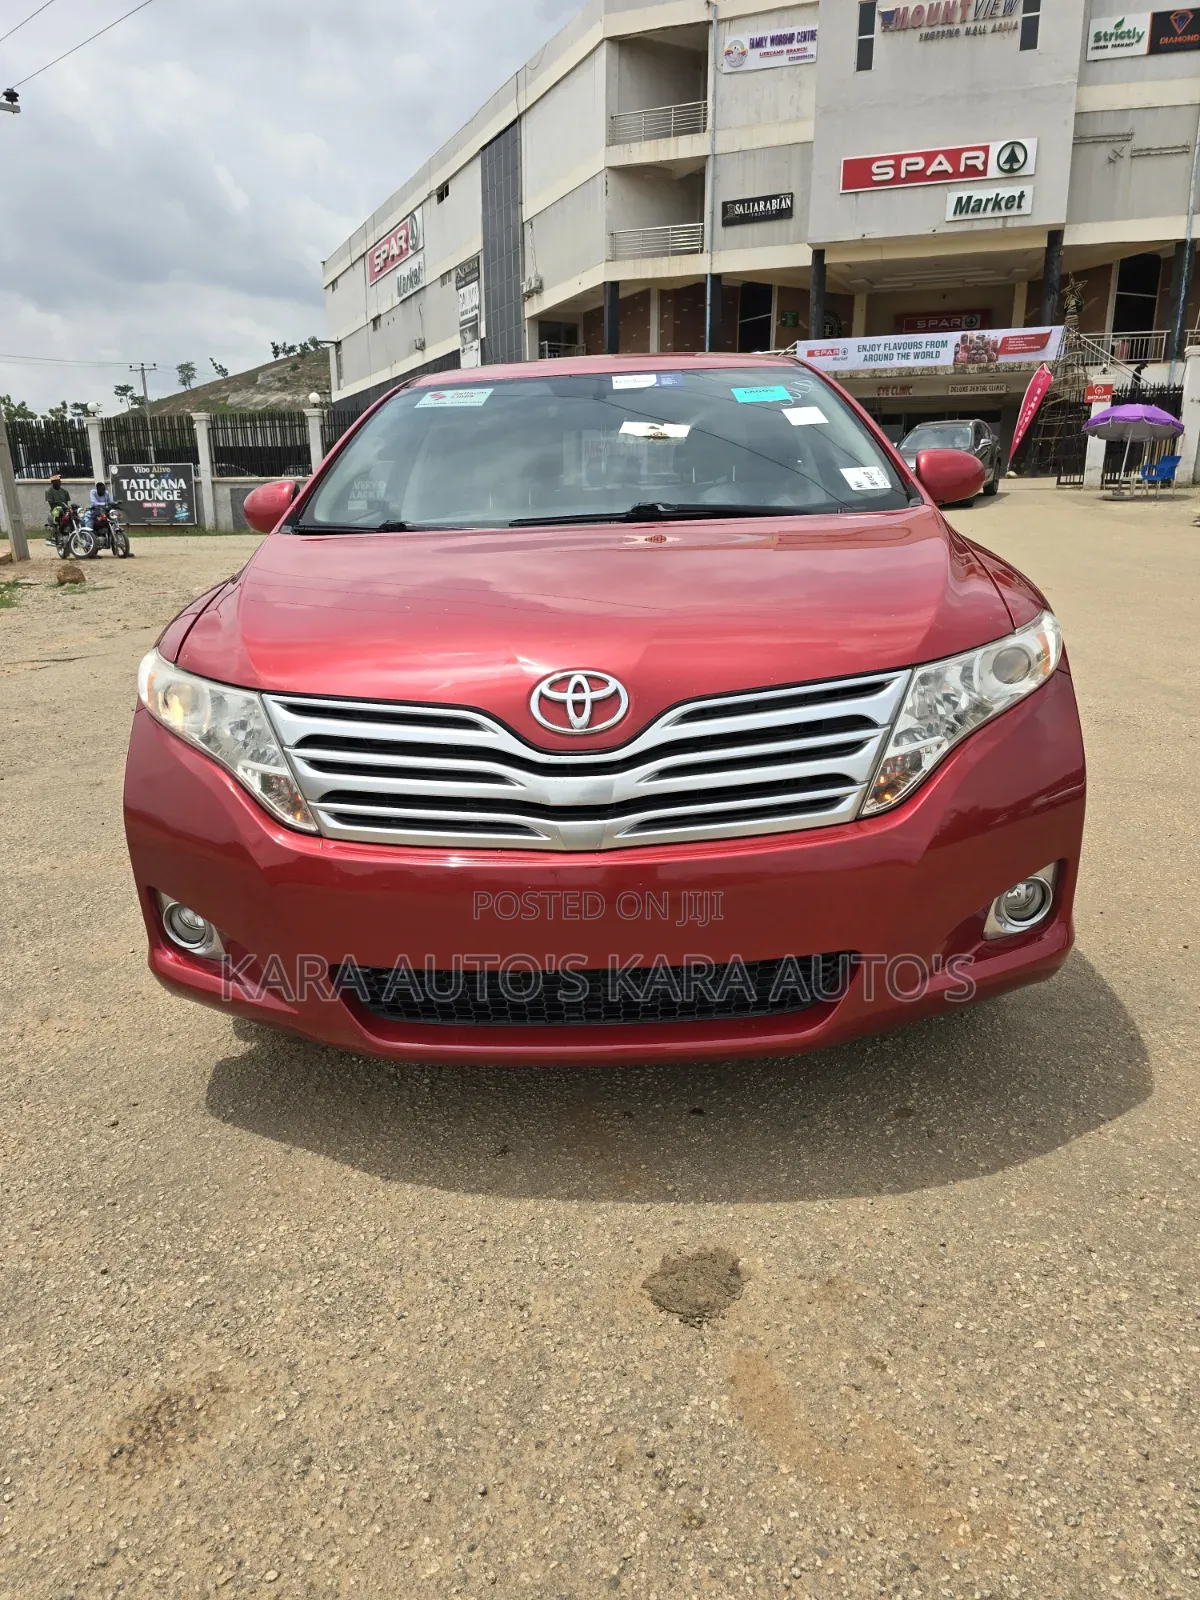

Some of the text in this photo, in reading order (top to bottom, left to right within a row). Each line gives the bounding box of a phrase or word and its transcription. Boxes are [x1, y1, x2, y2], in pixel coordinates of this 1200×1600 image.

[749, 29, 818, 49] FAMILY WORSHIP CENTRE
[919, 28, 960, 41] SHOPPING
[965, 25, 987, 36] MALL
[1093, 27, 1146, 43] Strictly
[1160, 34, 1200, 44] DIAMOND
[871, 151, 986, 182] SPAR
[953, 190, 1025, 216] Market
[374, 229, 408, 274] SPAR
[397, 261, 423, 298] Market
[917, 318, 961, 329] SPAR
[813, 349, 840, 357] SPAR
[857, 340, 948, 353] ENJOY FLAVOURS FROM
[863, 350, 941, 363] AROUND THE WORLD
[877, 386, 912, 397] EYE CLINIC
[120, 478, 187, 490] TATICANA
[126, 490, 182, 501] LOUNGE
